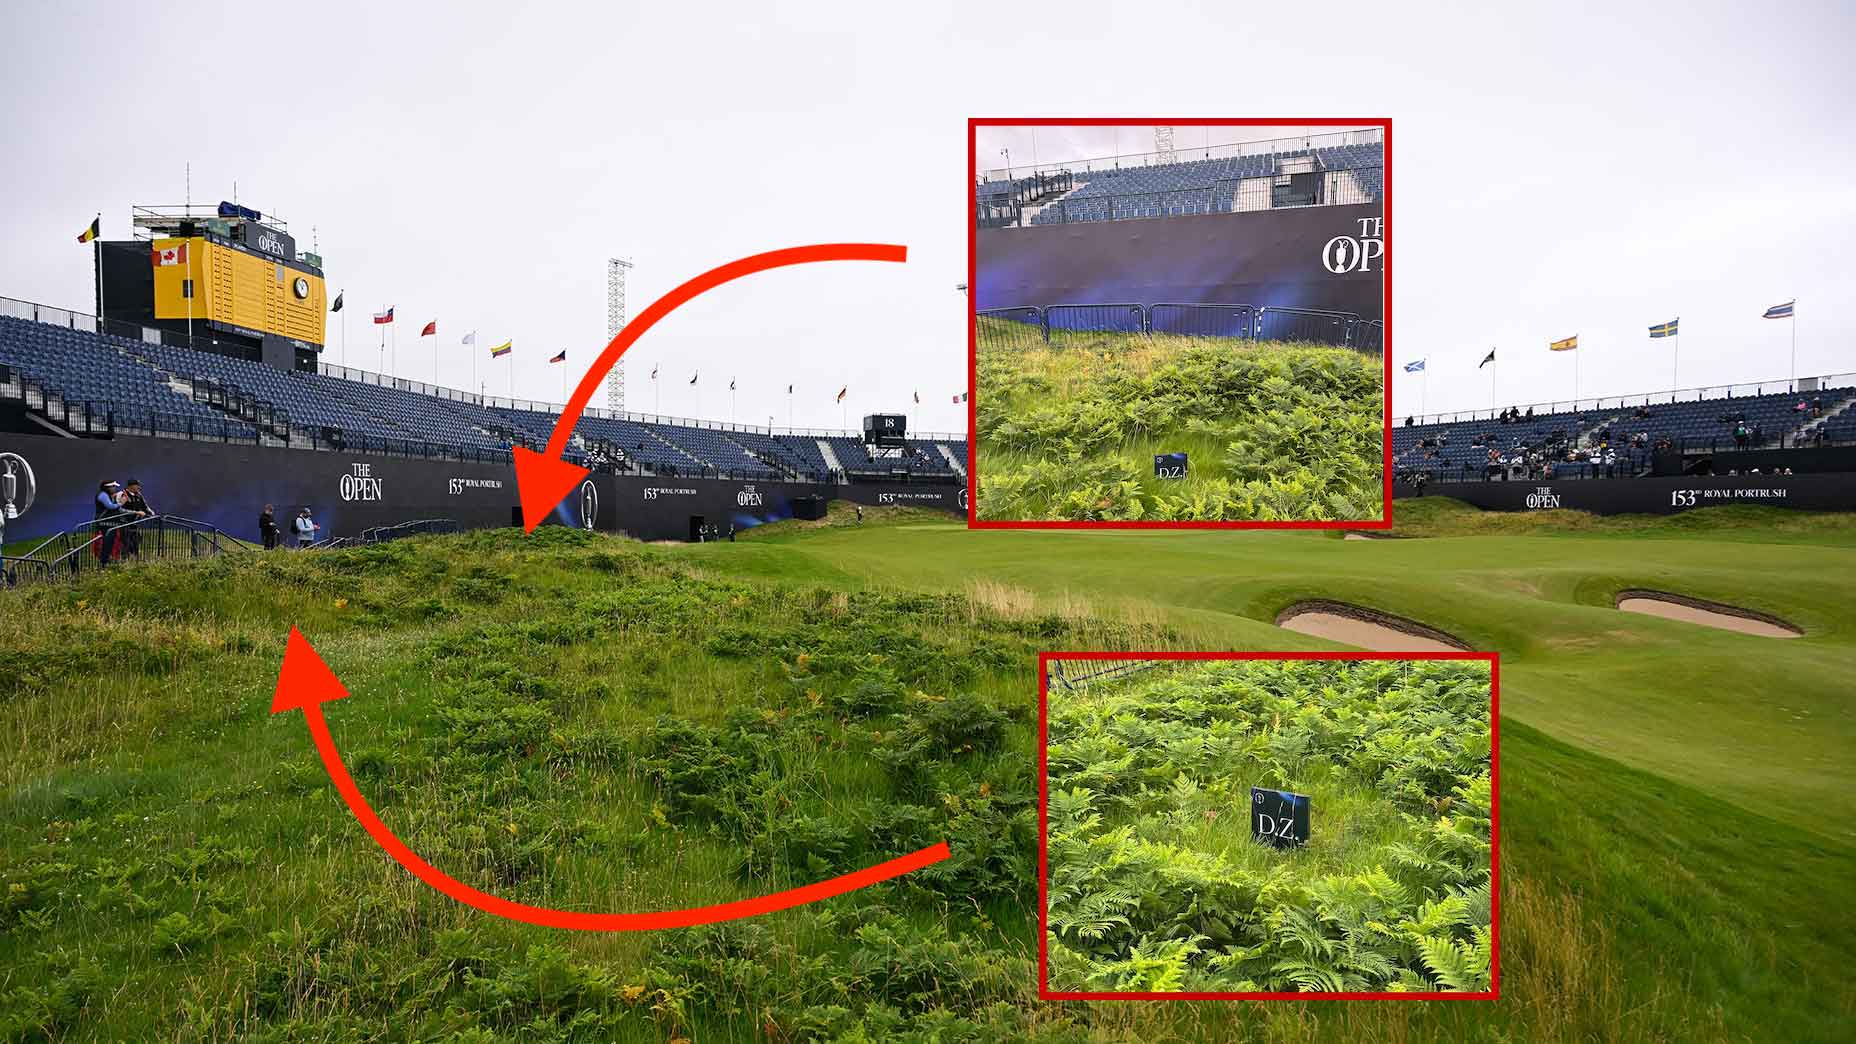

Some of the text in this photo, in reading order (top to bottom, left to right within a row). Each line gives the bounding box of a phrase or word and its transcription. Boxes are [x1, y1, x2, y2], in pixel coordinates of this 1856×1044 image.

[266, 231, 278, 240] THE
[258, 235, 285, 256] OPEN
[1322, 235, 1384, 274] OP
[885, 418, 895, 428] 18
[352, 463, 370, 477] THE
[1159, 466, 1183, 479] D.Z.
[340, 474, 382, 501] OPEN
[1536, 486, 1552, 495] THE
[1704, 489, 1733, 498] ROYAL
[1734, 488, 1787, 498] PORTRUSH
[737, 490, 762, 506] OPEN
[1526, 493, 1560, 508] OPEN
[1258, 813, 1299, 841] D.Z.
